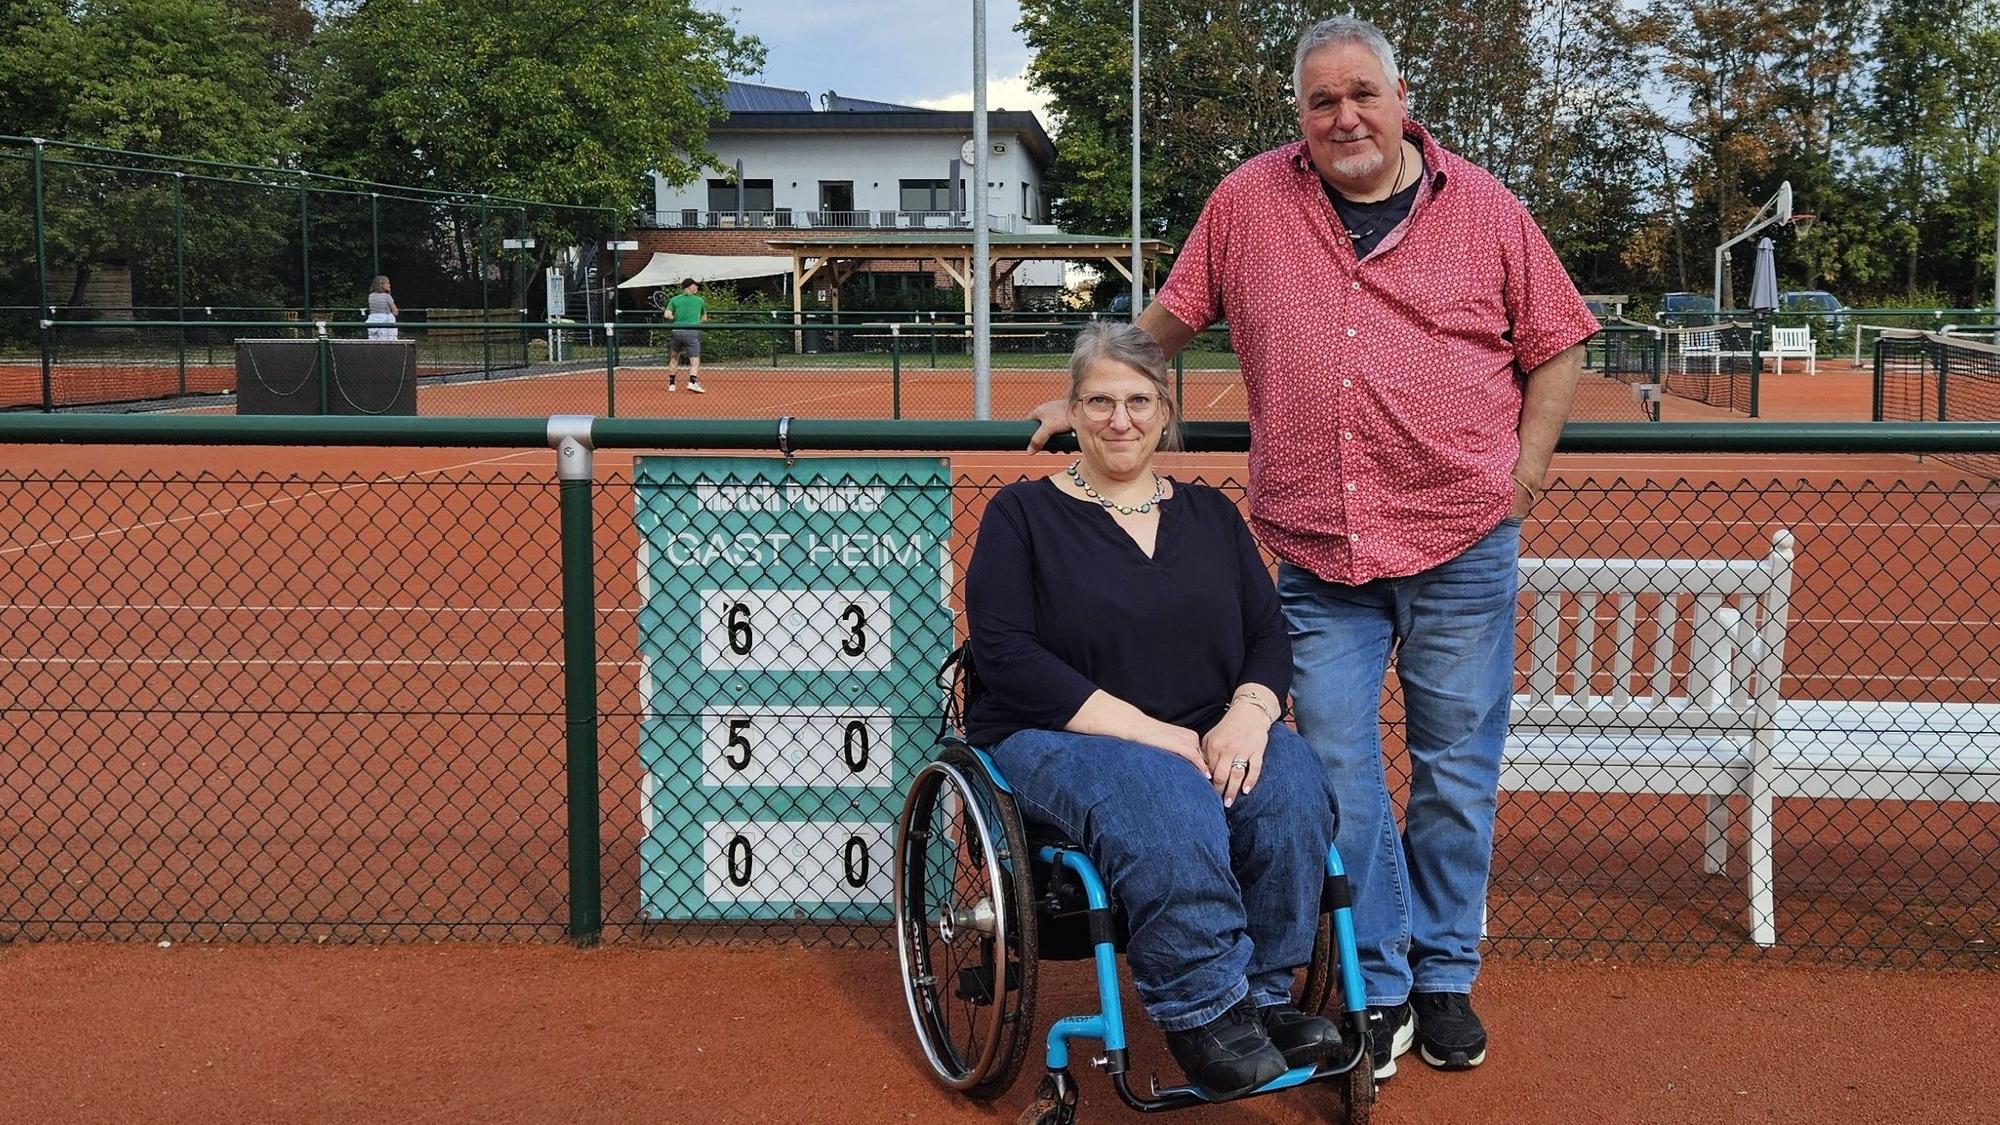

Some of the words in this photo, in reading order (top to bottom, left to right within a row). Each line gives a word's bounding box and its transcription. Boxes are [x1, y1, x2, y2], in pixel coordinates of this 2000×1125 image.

[697, 482, 781, 512] Match
[786, 482, 886, 513] Pointer
[667, 533, 791, 567] GAST
[808, 533, 922, 567] HEIM
[727, 603, 753, 656] 6
[841, 604, 866, 657] 3
[726, 719, 751, 771] 5
[844, 720, 869, 773] 0
[727, 834, 753, 888] 0
[844, 835, 869, 889] 0
